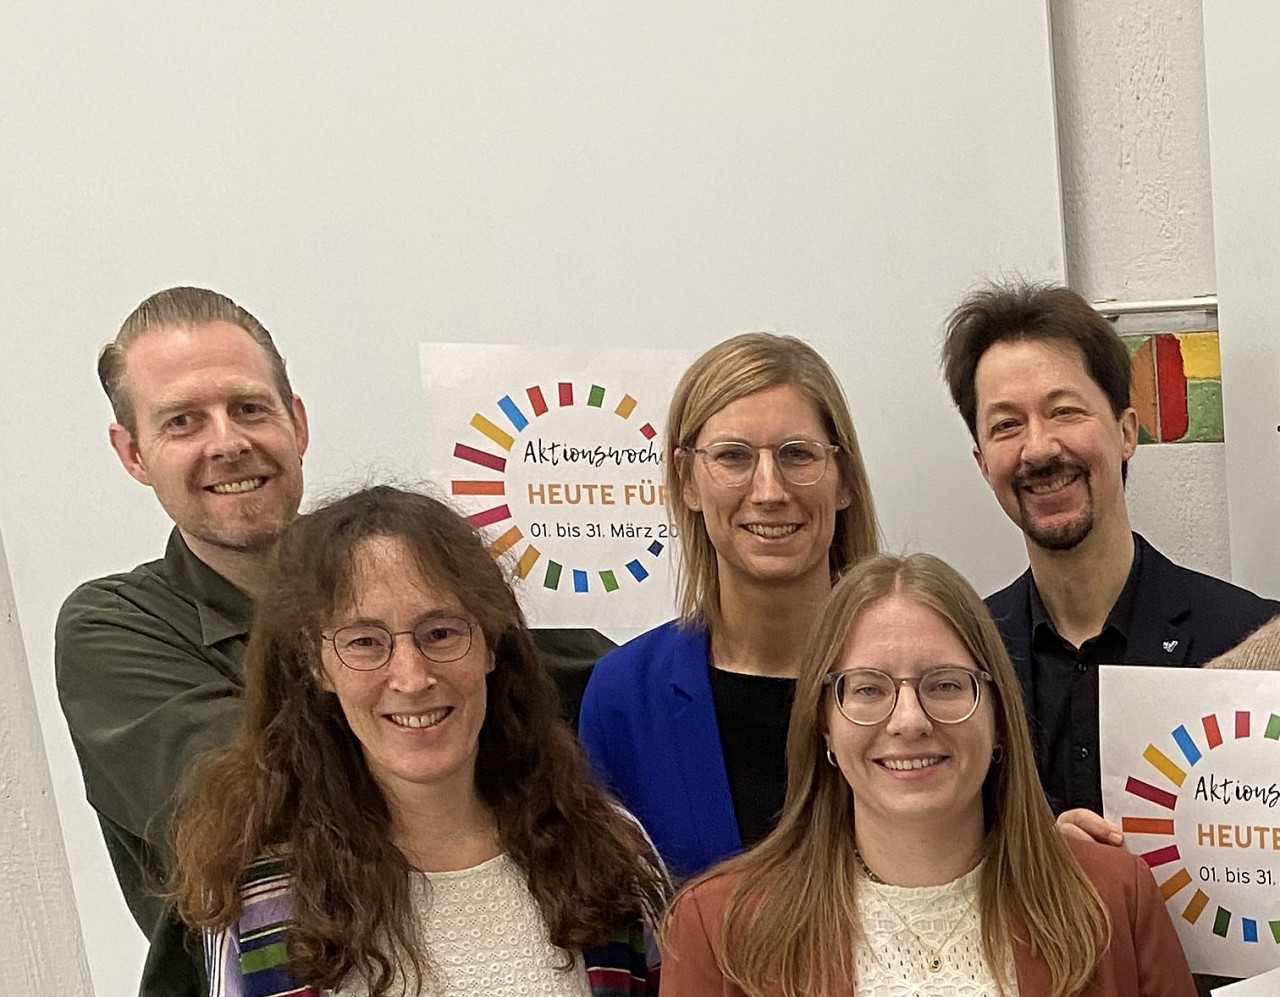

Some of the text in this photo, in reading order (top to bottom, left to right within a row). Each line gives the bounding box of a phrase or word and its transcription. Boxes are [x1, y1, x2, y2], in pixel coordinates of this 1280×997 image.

[524, 438, 664, 467] Aktionswoch
[527, 483, 615, 505] HEUTE
[530, 523, 679, 538] 01. bis 31. März 20
[1199, 866, 1220, 882] 01.
[1226, 867, 1250, 884] bis
[1256, 869, 1276, 886] 31.
